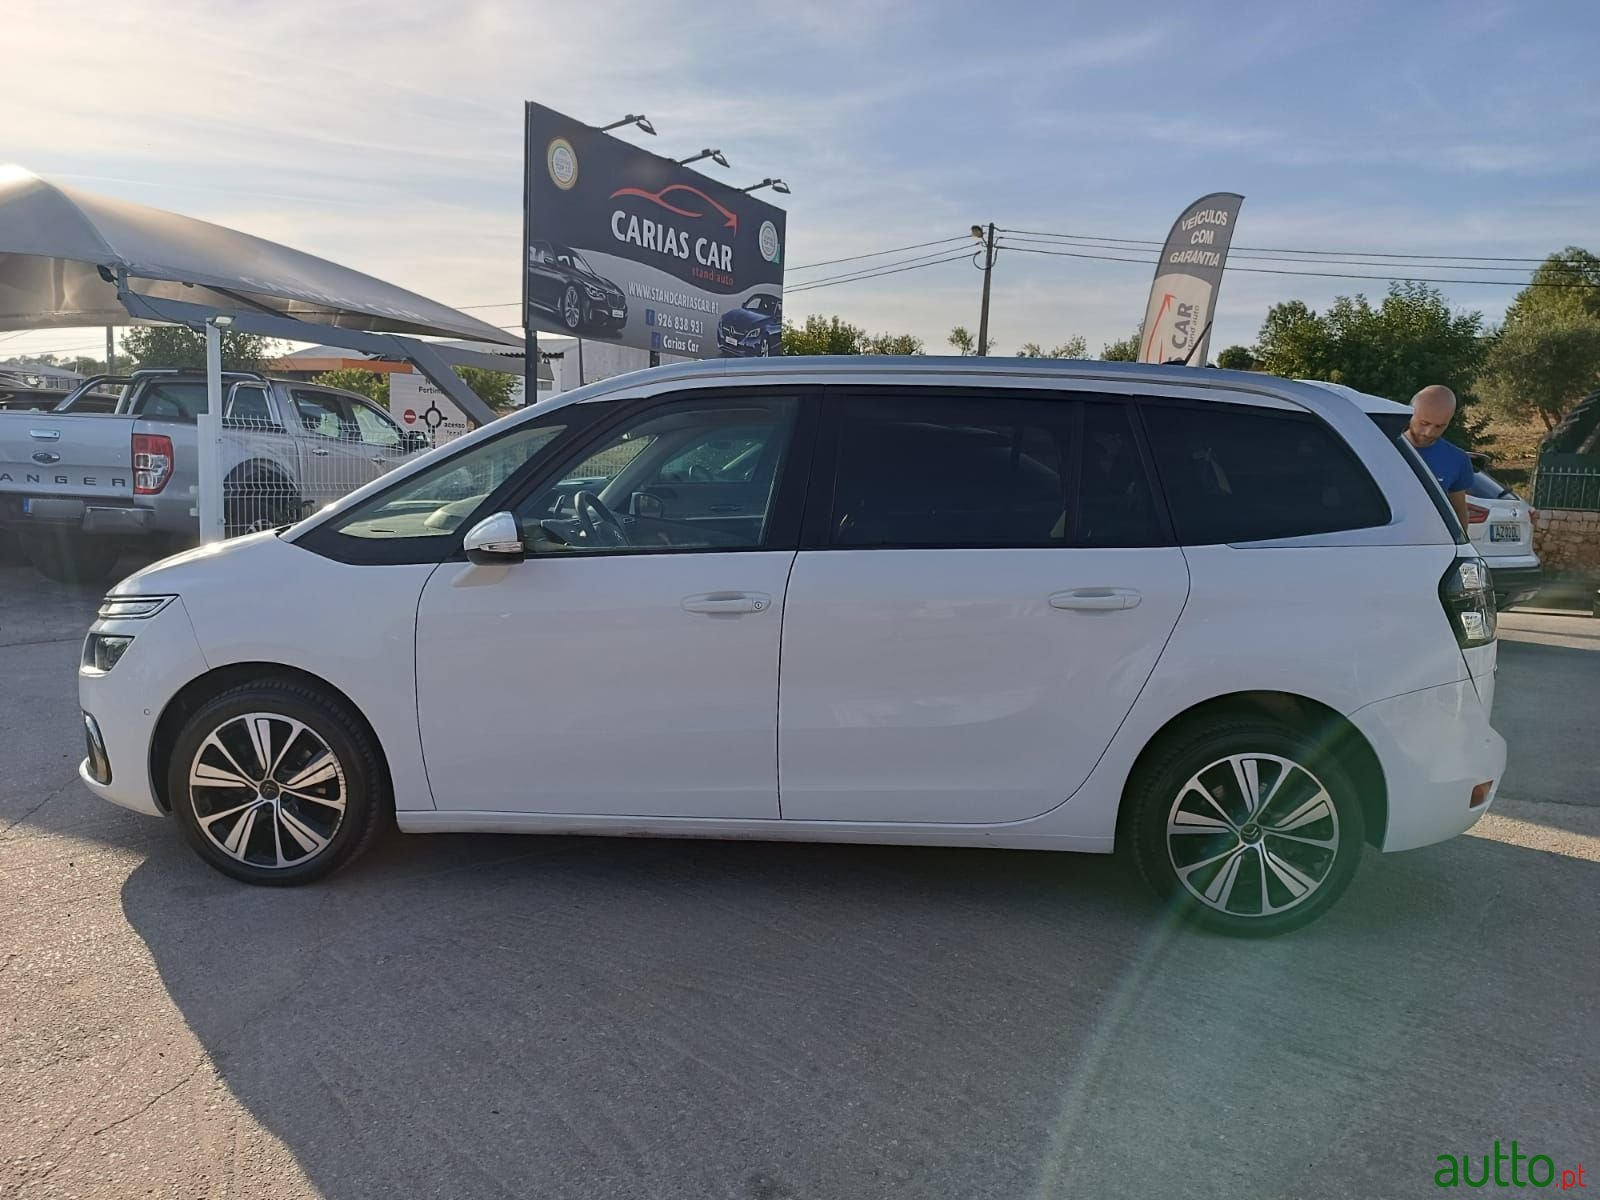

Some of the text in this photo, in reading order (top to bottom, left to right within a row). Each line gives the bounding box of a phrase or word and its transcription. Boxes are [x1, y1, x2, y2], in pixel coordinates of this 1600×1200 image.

[1182, 209, 1228, 231] VEÍCULOS
[611, 210, 689, 259] CARIAS
[695, 237, 732, 272] CAR
[1190, 229, 1214, 245] COM
[1170, 250, 1220, 266] GARANTIA
[692, 266, 714, 281] stand
[657, 313, 704, 334] 926 838 931
[1172, 303, 1193, 349] CAR
[663, 335, 699, 352] Carias Car
[0, 473, 126, 487] ANGER
